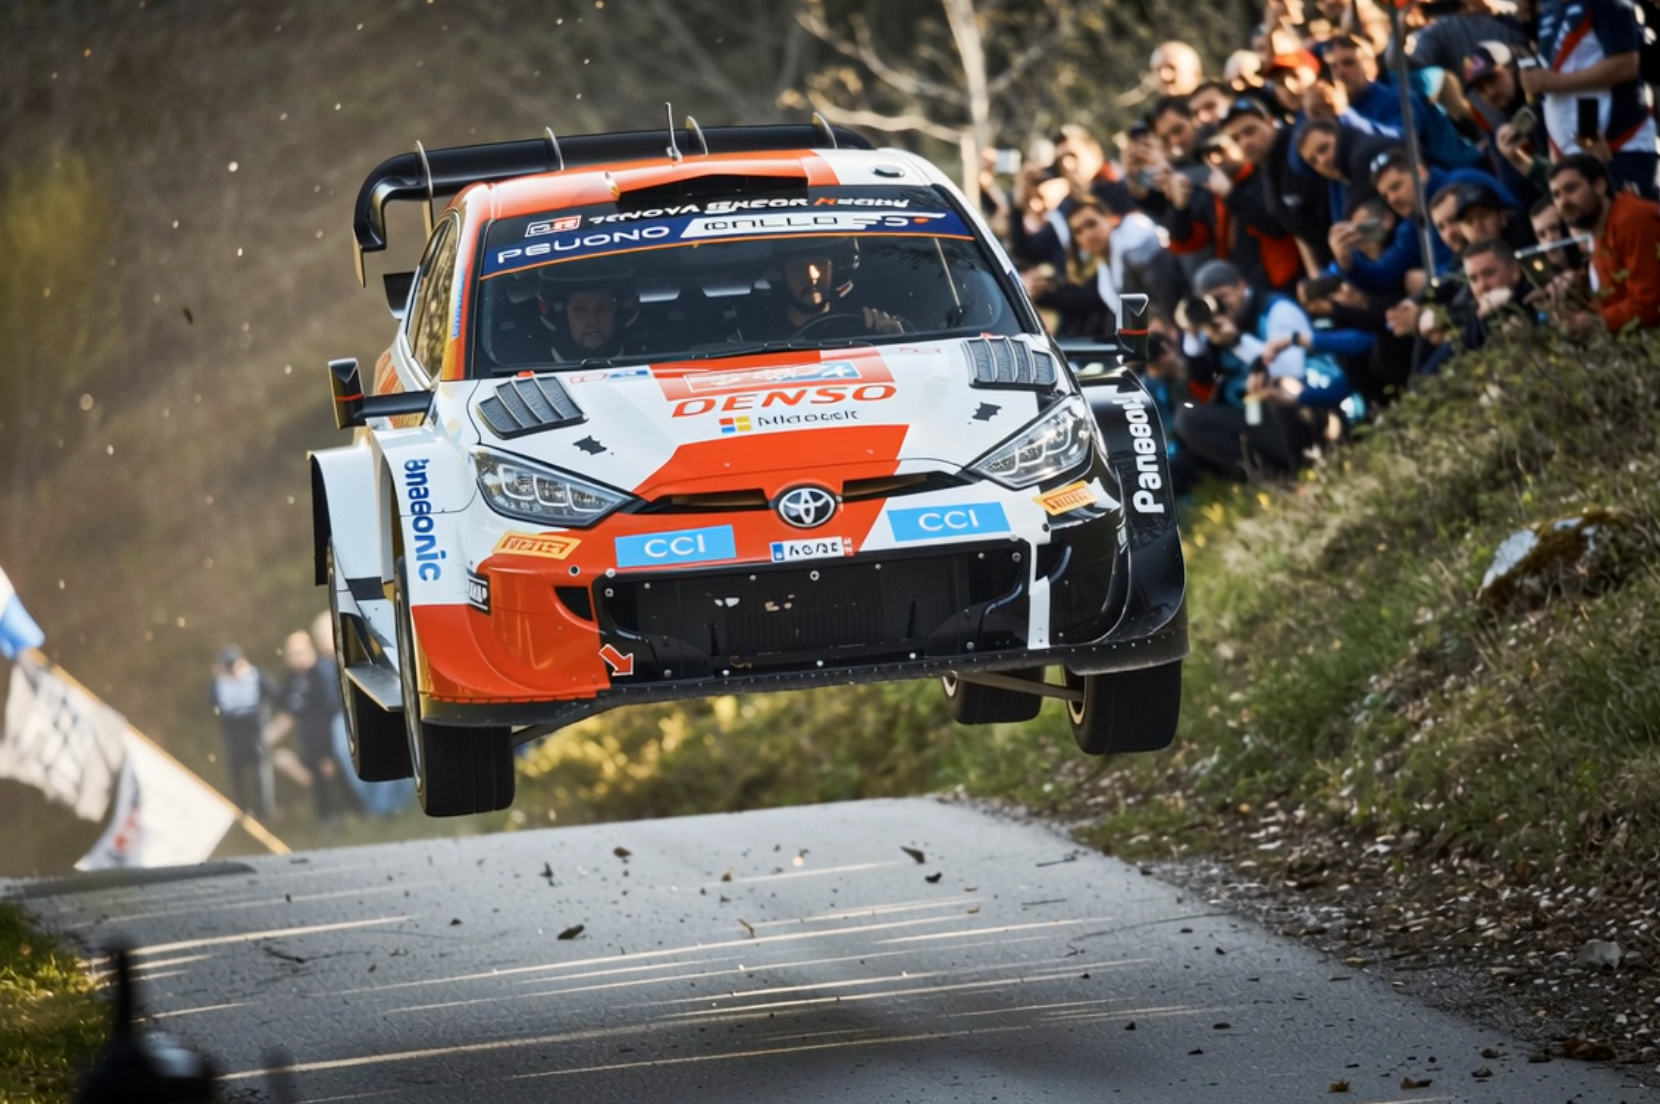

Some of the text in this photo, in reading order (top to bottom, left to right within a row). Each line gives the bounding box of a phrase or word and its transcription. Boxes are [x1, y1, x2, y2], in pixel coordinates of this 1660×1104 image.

[672, 385, 897, 418] DENSO
[918, 508, 979, 532] CCI
[644, 533, 706, 558] CCI
